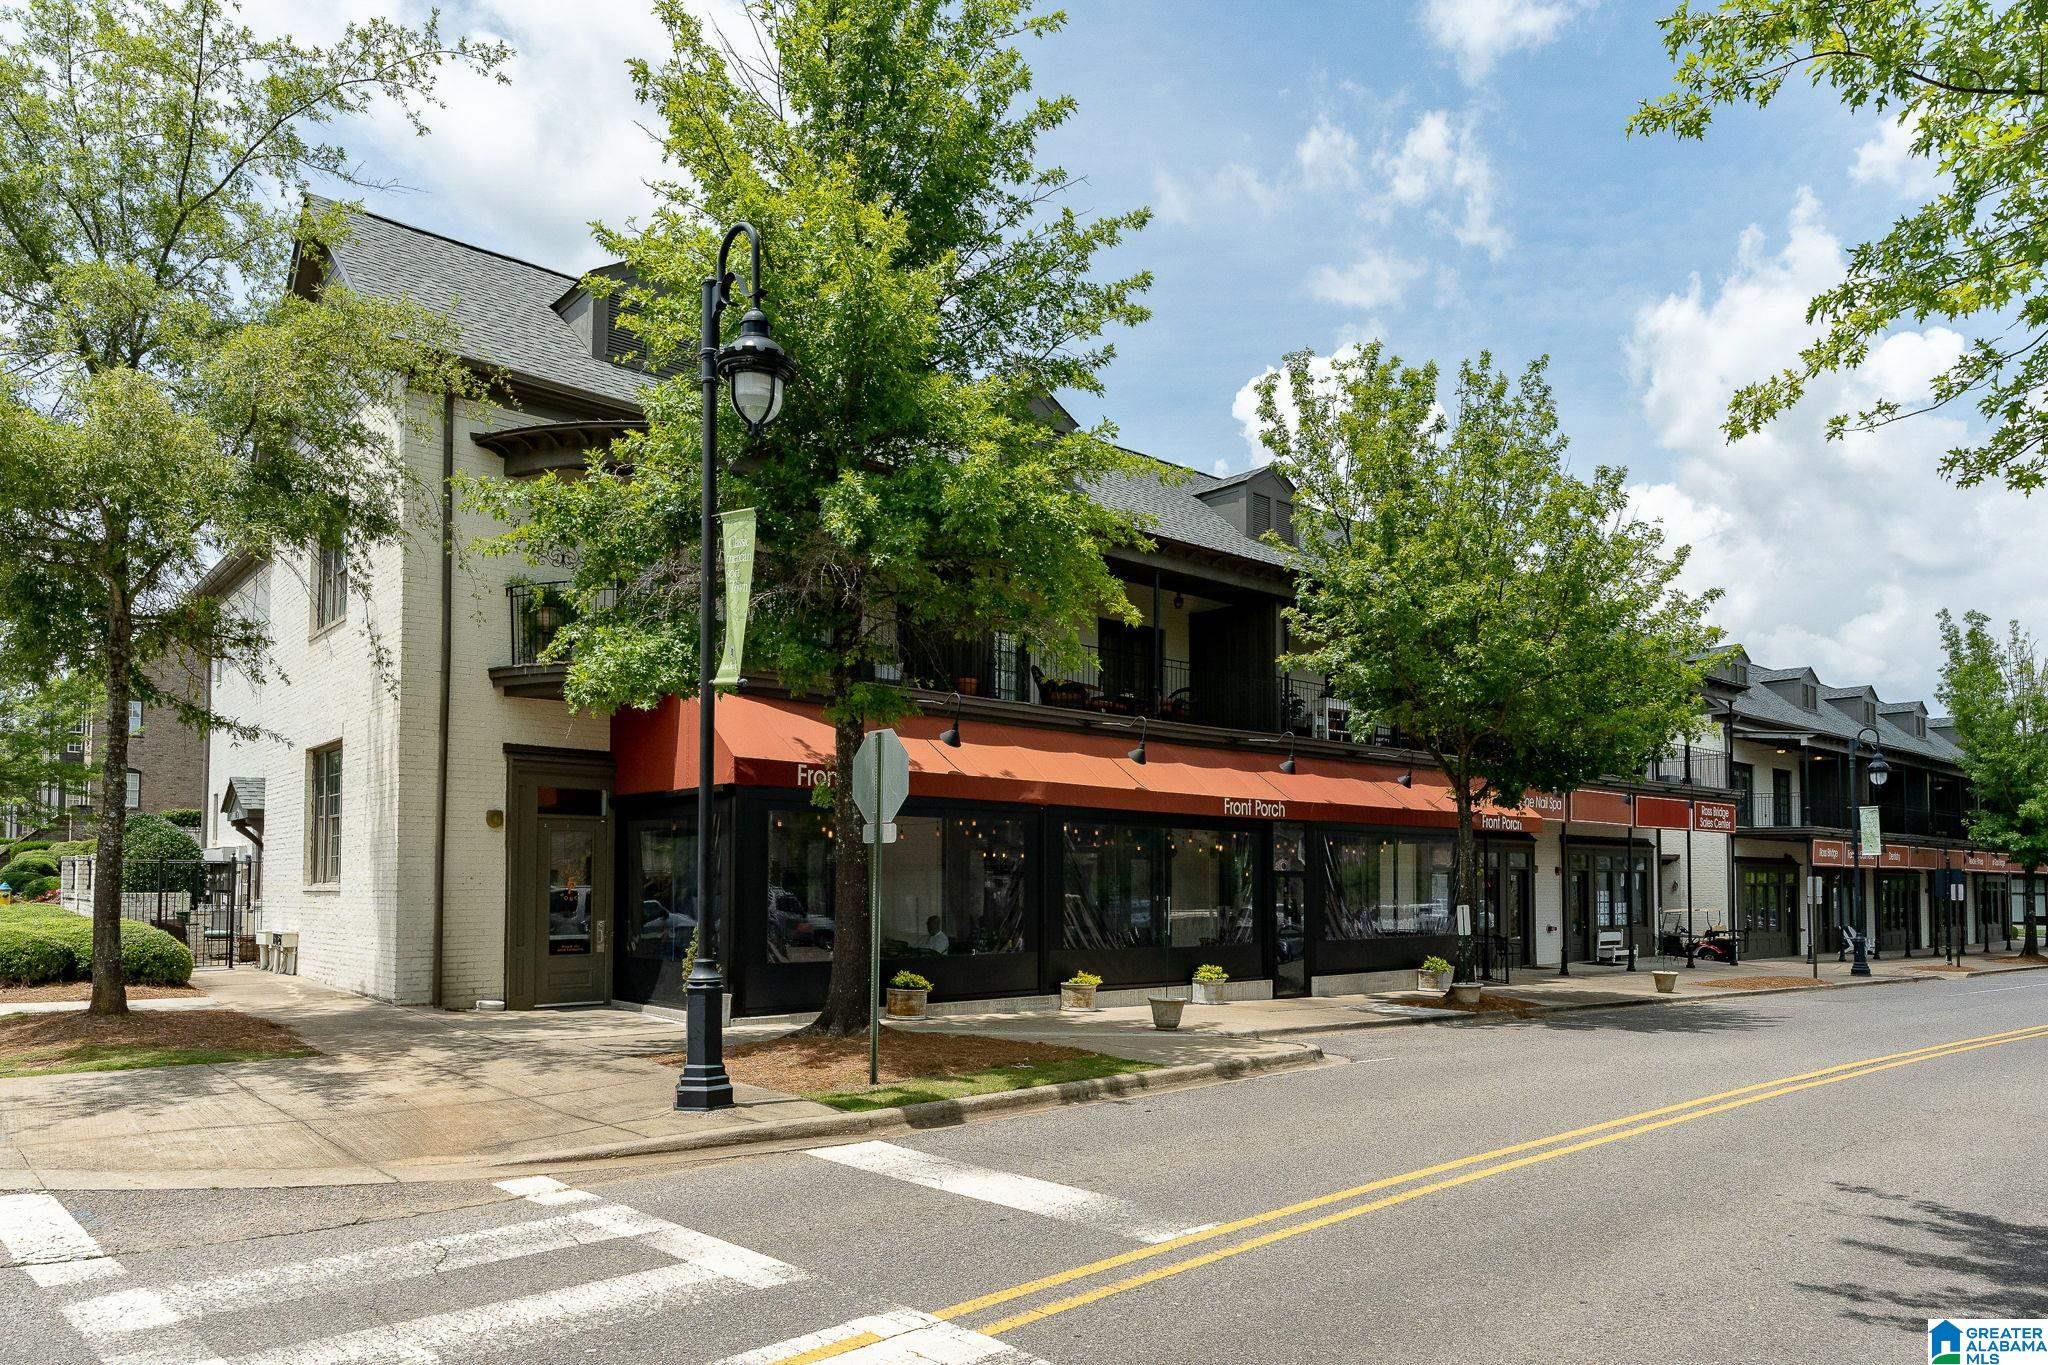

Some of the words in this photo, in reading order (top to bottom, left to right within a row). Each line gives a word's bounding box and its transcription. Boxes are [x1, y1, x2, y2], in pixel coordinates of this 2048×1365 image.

[726, 552, 752, 563] merican
[797, 764, 838, 787] Fron
[1224, 798, 1251, 816] Front
[1255, 800, 1286, 817] Porch
[1536, 796, 1548, 809] Nail
[1549, 797, 1562, 812] Spa
[1701, 805, 1713, 816] Ross
[1713, 806, 1729, 819] Bridge
[1482, 815, 1500, 829] Front
[1502, 816, 1523, 831] Porch
[1700, 817, 1713, 828] Sales
[1714, 818, 1732, 829] Center
